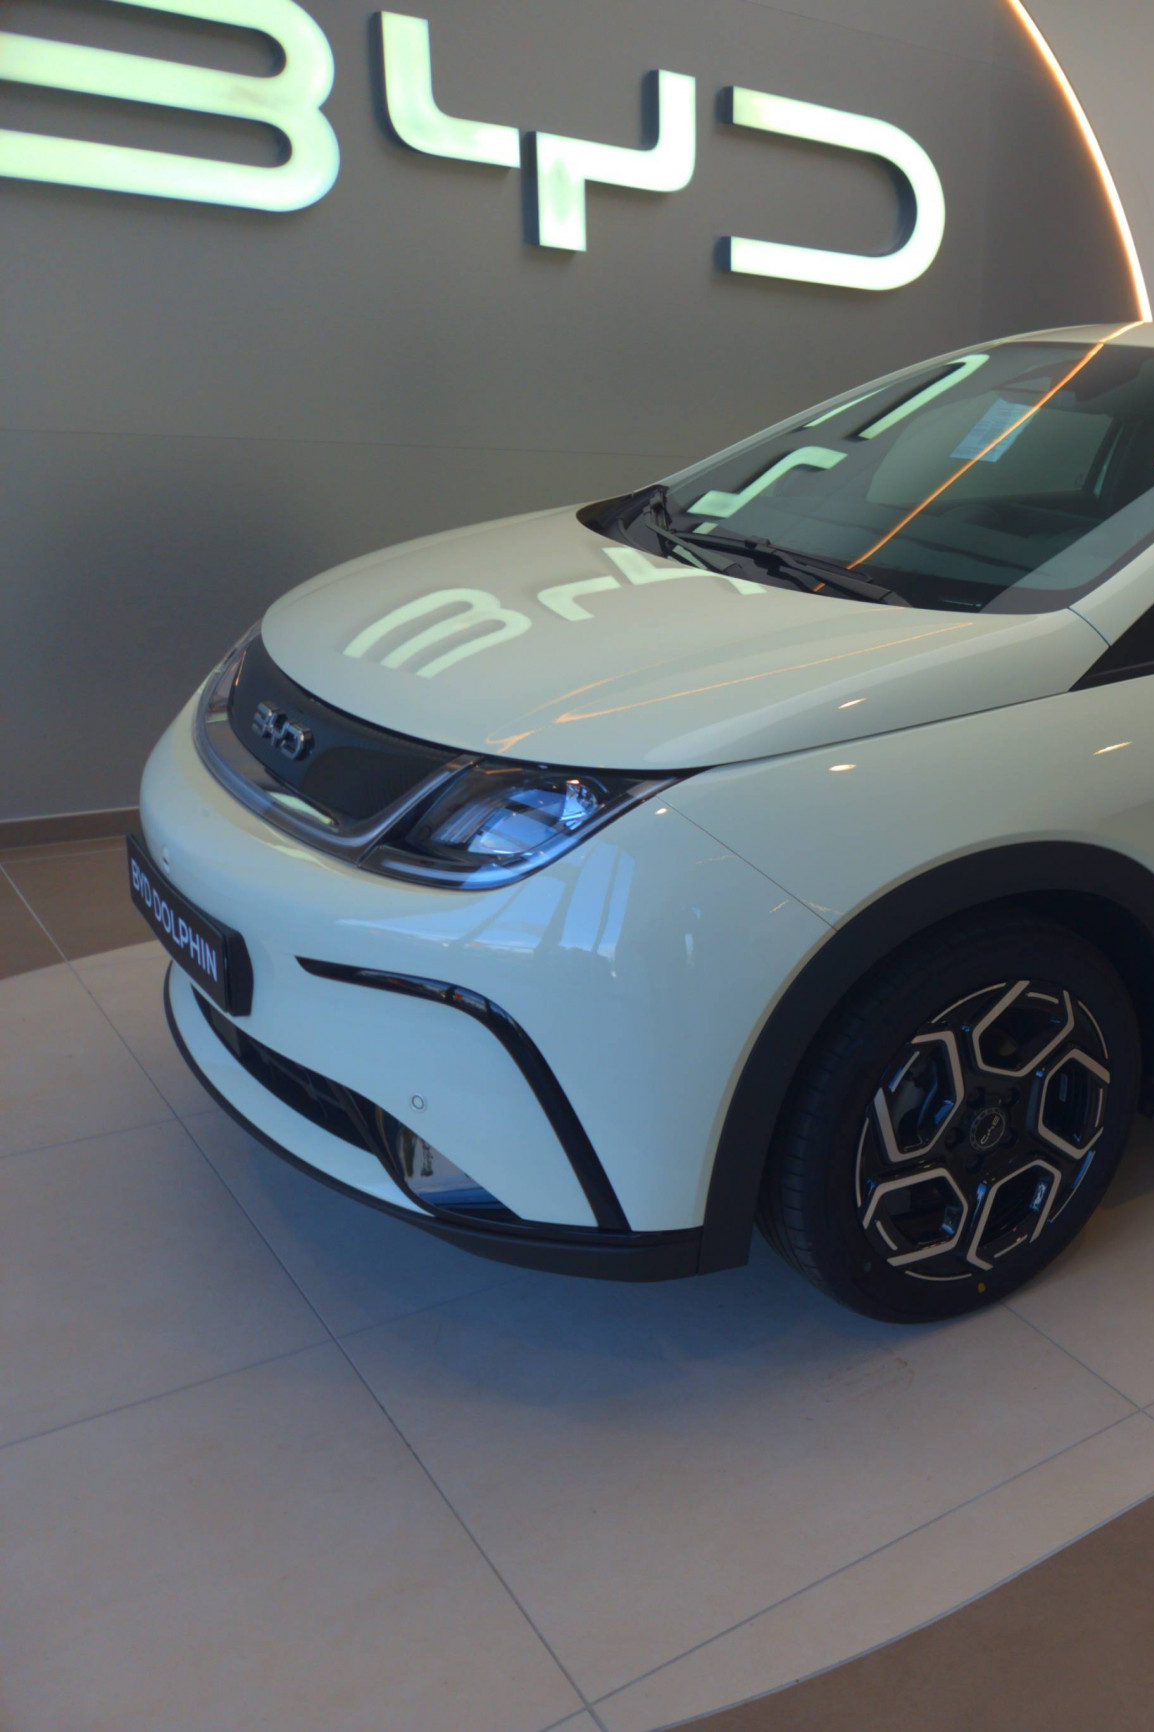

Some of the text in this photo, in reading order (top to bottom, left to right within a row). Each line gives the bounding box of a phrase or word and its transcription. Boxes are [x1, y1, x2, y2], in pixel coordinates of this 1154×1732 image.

[0, 0, 946, 291] BYD
[130, 856, 218, 983] BYD DOLPHIN
